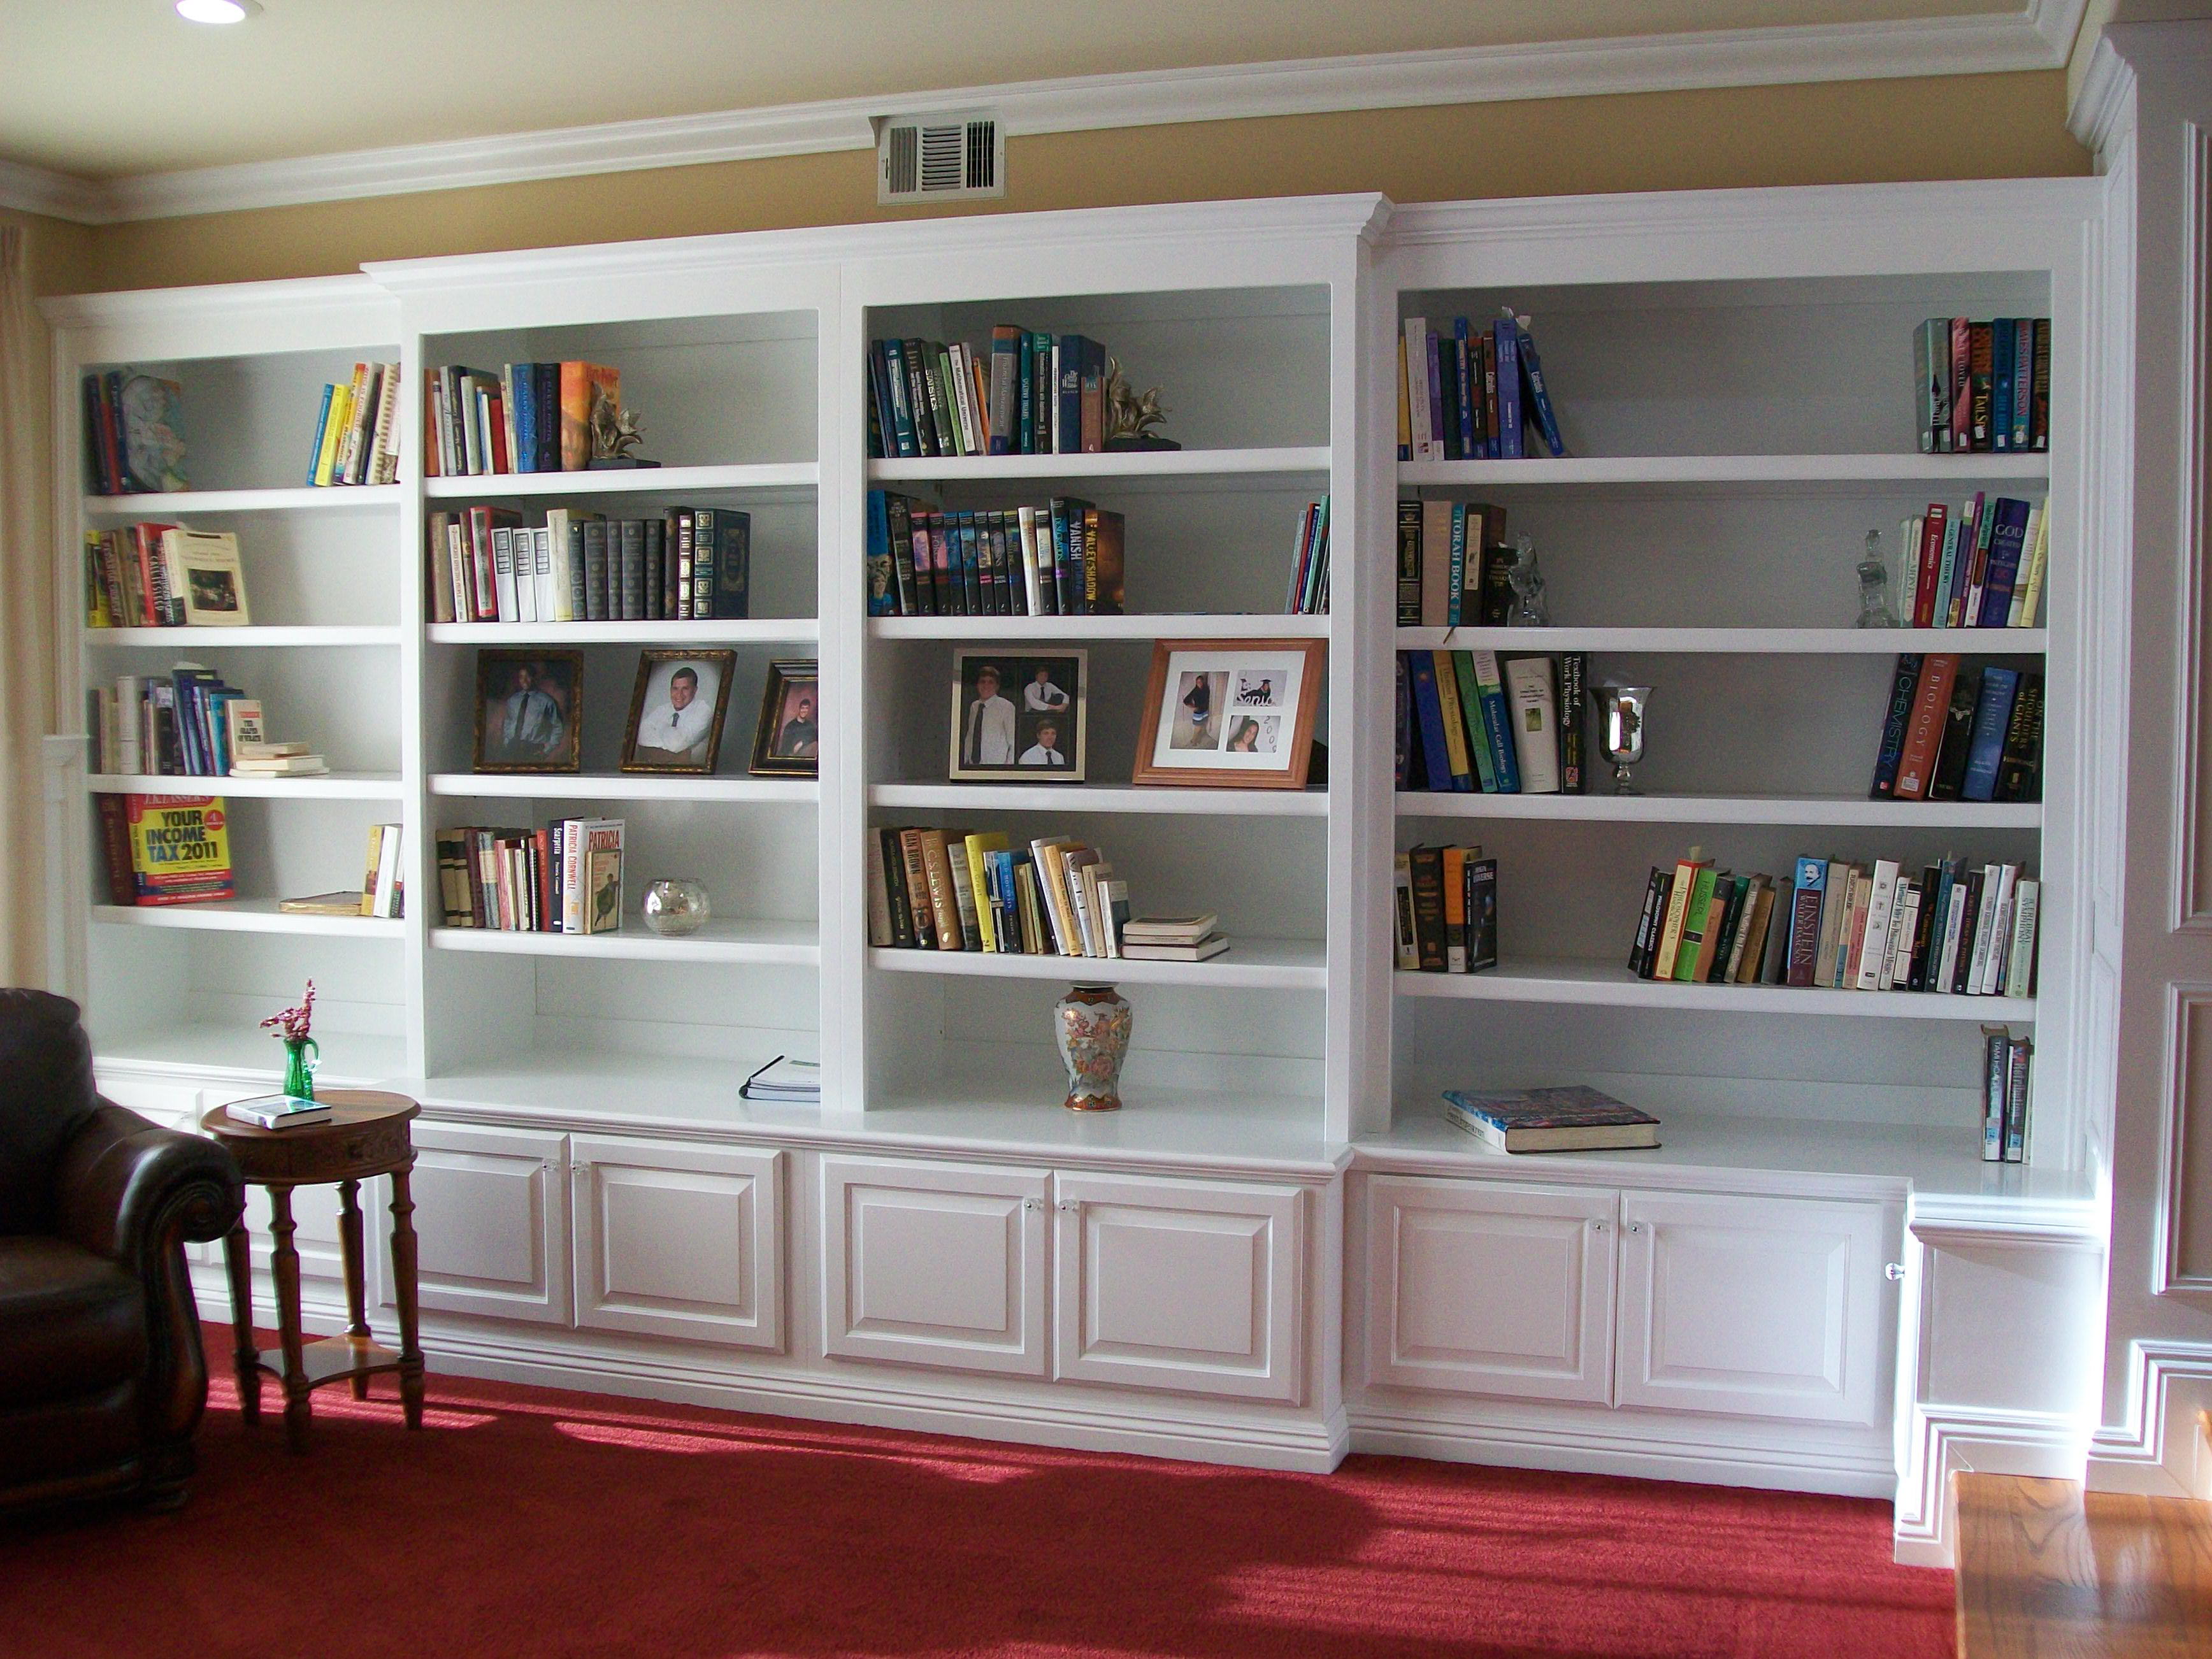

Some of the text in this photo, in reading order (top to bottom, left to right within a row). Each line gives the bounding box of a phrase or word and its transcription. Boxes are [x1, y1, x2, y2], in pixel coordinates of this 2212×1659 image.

[1486, 371, 1495, 394] Calculus
[1531, 371, 1543, 393] Calculus
[1958, 361, 1966, 387] LOVED
[2016, 356, 2029, 417] PATTERSON
[954, 367, 967, 406] Mathematical
[961, 407, 970, 431] Universe
[1070, 521, 1082, 561] VANISH
[1927, 533, 1939, 570] Economics
[1945, 529, 1955, 559] GENERAL
[1995, 524, 2024, 538] GOD
[1086, 530, 1096, 601] VALLEY SHADOW
[1451, 519, 1462, 600] TORAH BOOK
[152, 586, 162, 611] SLEEP
[1572, 656, 1581, 707] Textbook of
[1562, 682, 1572, 727] Physiology
[1883, 677, 1912, 768] CHEMISTRY
[1916, 675, 1941, 746] BIOLOGY
[2009, 704, 2025, 742] GIANTS
[2018, 689, 2038, 749] SHOULDERS
[1488, 700, 1507, 775] Molecular Cell Biology
[146, 826, 206, 845] INCOME
[161, 810, 203, 827] YOUR
[147, 841, 218, 863] TAX 2011
[552, 828, 563, 855] Scarpetta
[566, 824, 578, 891] PATRICIA CORNWELL
[589, 830, 620, 852] PATRICIA
[904, 833, 921, 875] DAN BROWN
[927, 850, 943, 908] C.S. LEWIS
[1003, 875, 1013, 909] MOUNTAIN
[1693, 880, 1711, 917] HUSSERL
[1648, 895, 1663, 952] PHILOSOPHY CLASSICS
[1669, 886, 1688, 940] PHILOSOPHER'S
[1728, 891, 1756, 973] William Safire On Language
[1793, 894, 1807, 965] WALTER ISAACSON
[1800, 896, 1818, 965] EINSTEIN
[2017, 897, 2029, 944] SYMPHONY
[2025, 902, 2034, 944] CEREBRAL
[1912, 940, 1921, 959] Mind
[1958, 947, 1967, 973] PHYSICS
[1992, 1040, 2001, 1087] TAMI HOAG
[2013, 1063, 2027, 1117] Retribution
